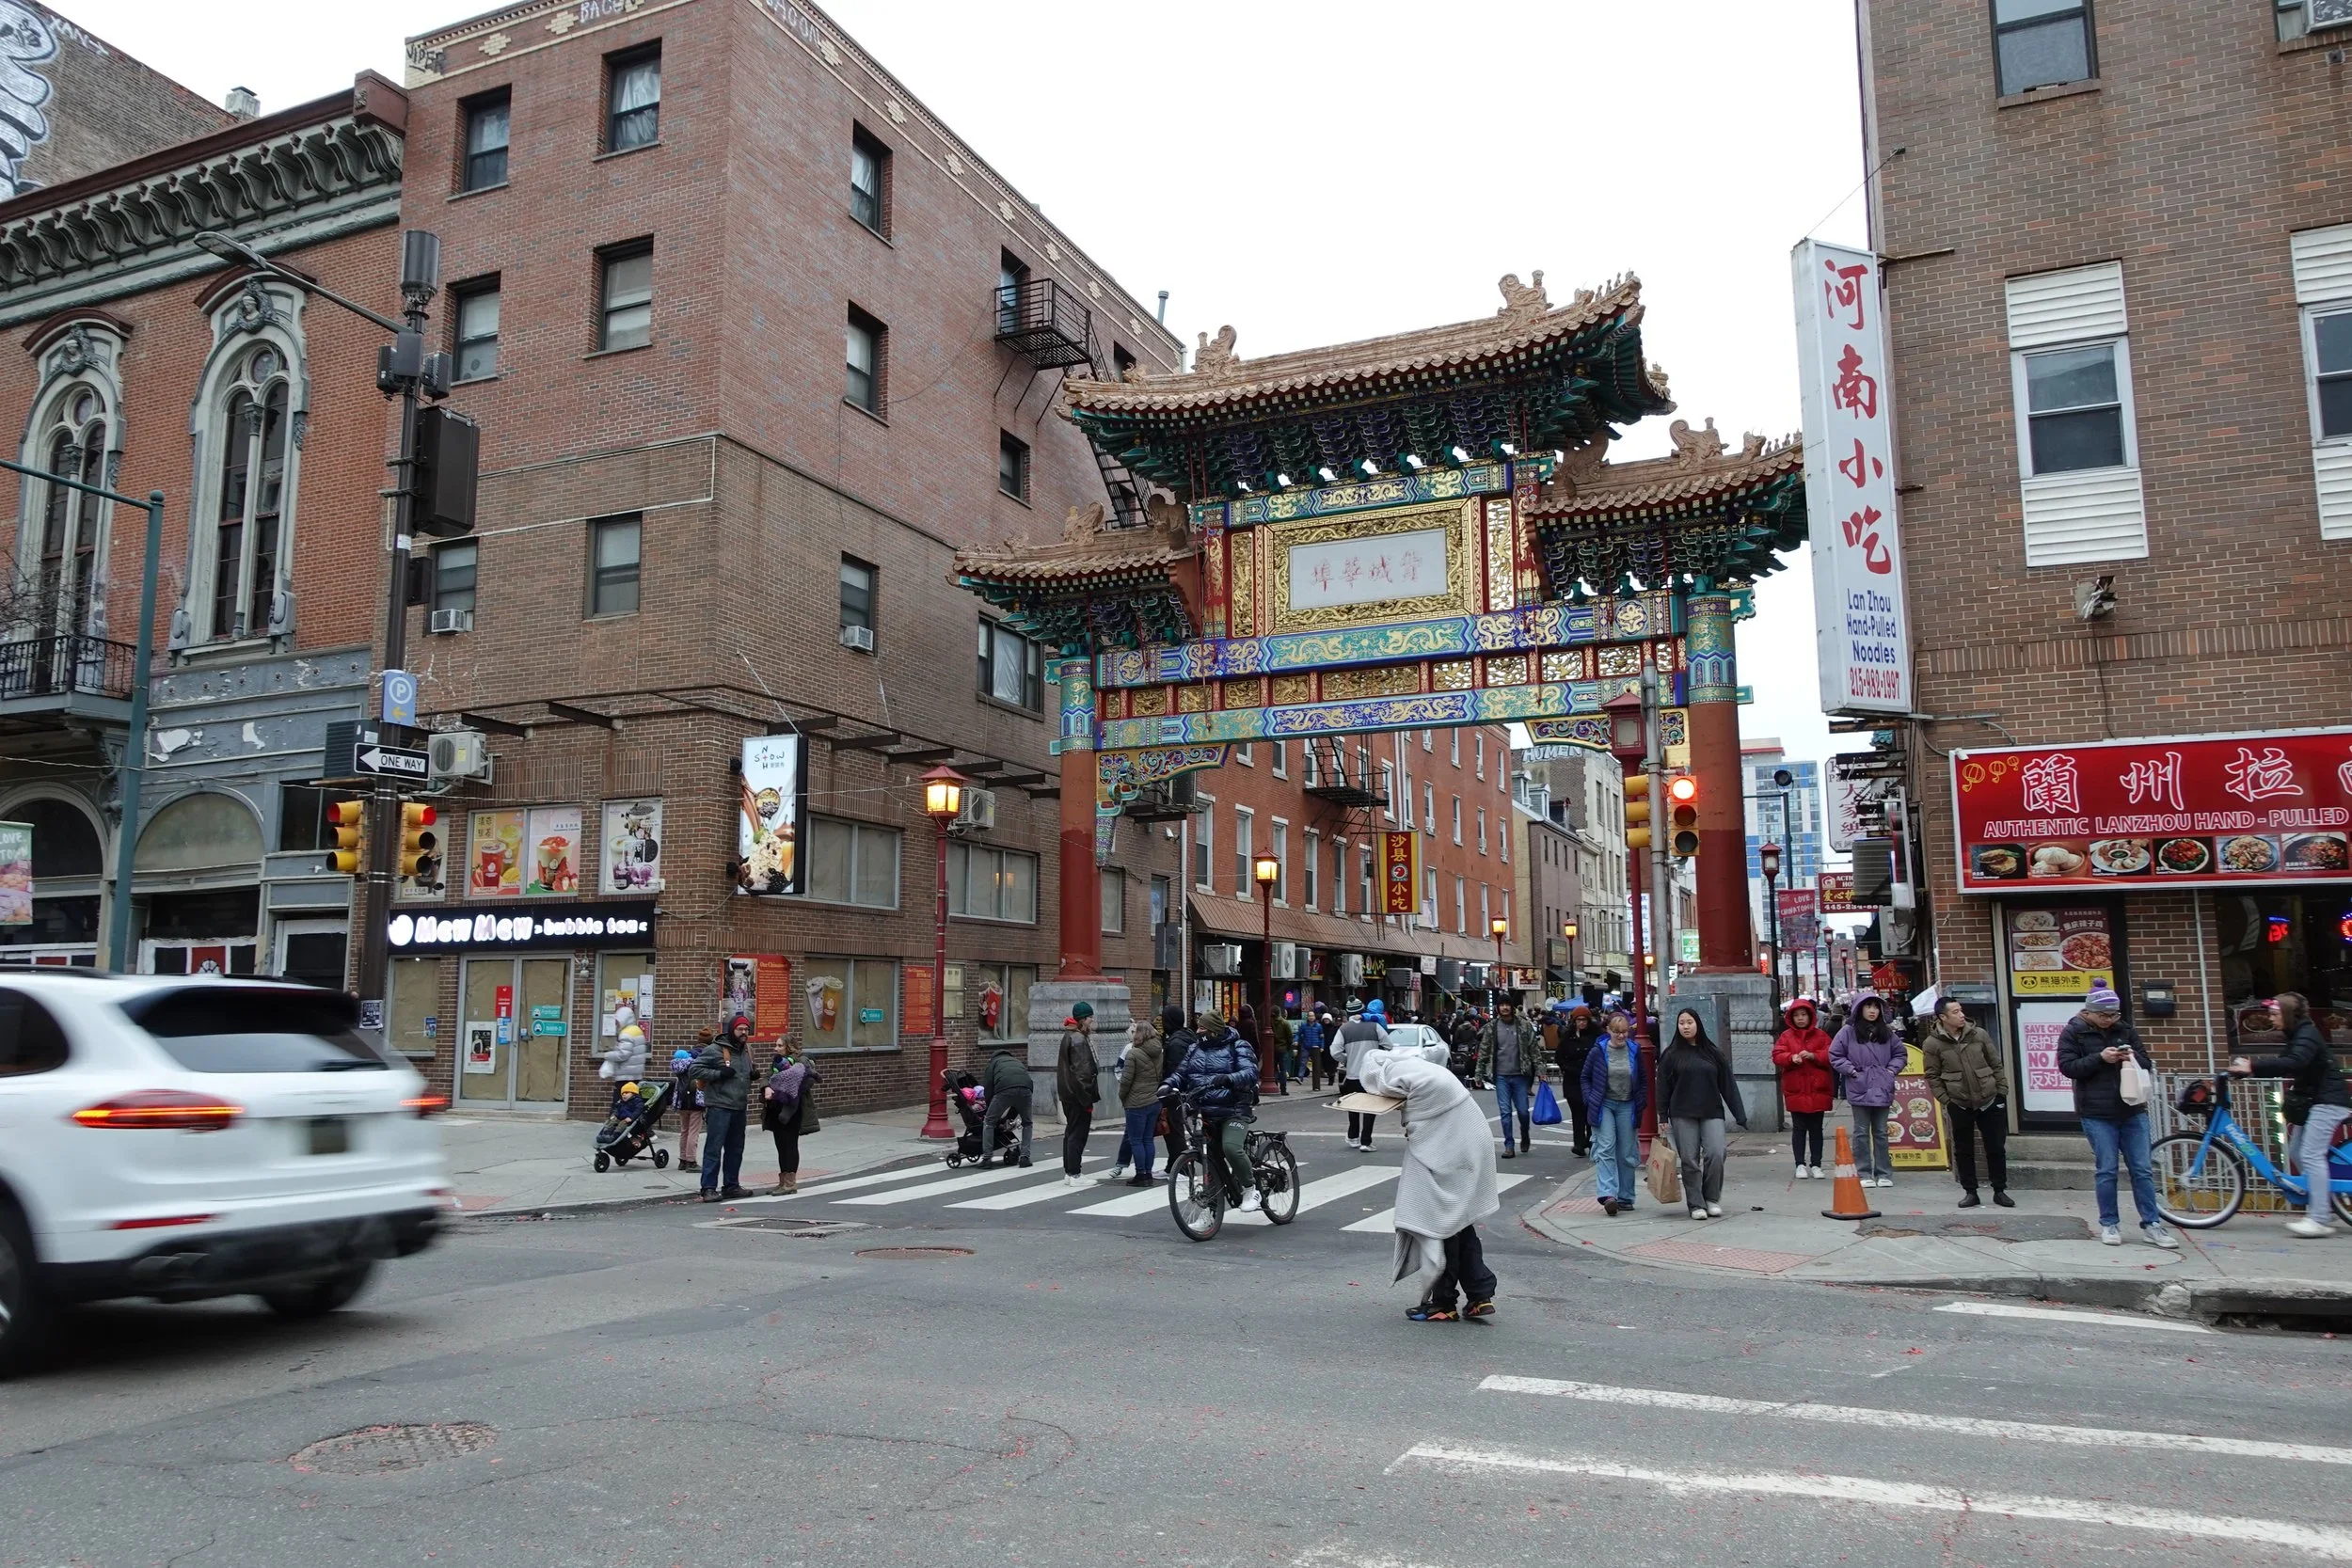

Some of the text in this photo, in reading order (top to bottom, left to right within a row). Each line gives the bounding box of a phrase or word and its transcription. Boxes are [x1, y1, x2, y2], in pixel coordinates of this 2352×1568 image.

[1824, 259, 1892, 576] 河南小吃
[1847, 588, 1891, 613] Lan Zhou
[1846, 613, 1897, 639] Hand-Pulled
[1852, 640, 1896, 664] Noodles
[380, 755, 422, 770] ONE WAY
[2022, 746, 2352, 815] 蘭州拉
[1983, 816, 2090, 838] AUTHENTIC
[2095, 814, 2191, 834] LANZHOU
[2195, 810, 2255, 830] HAND
[2268, 807, 2350, 828] PULLED
[1391, 834, 1408, 911] 沙县 小吃
[2025, 1024, 2046, 1033] SAVE
[2028, 1053, 2049, 1068] NO
